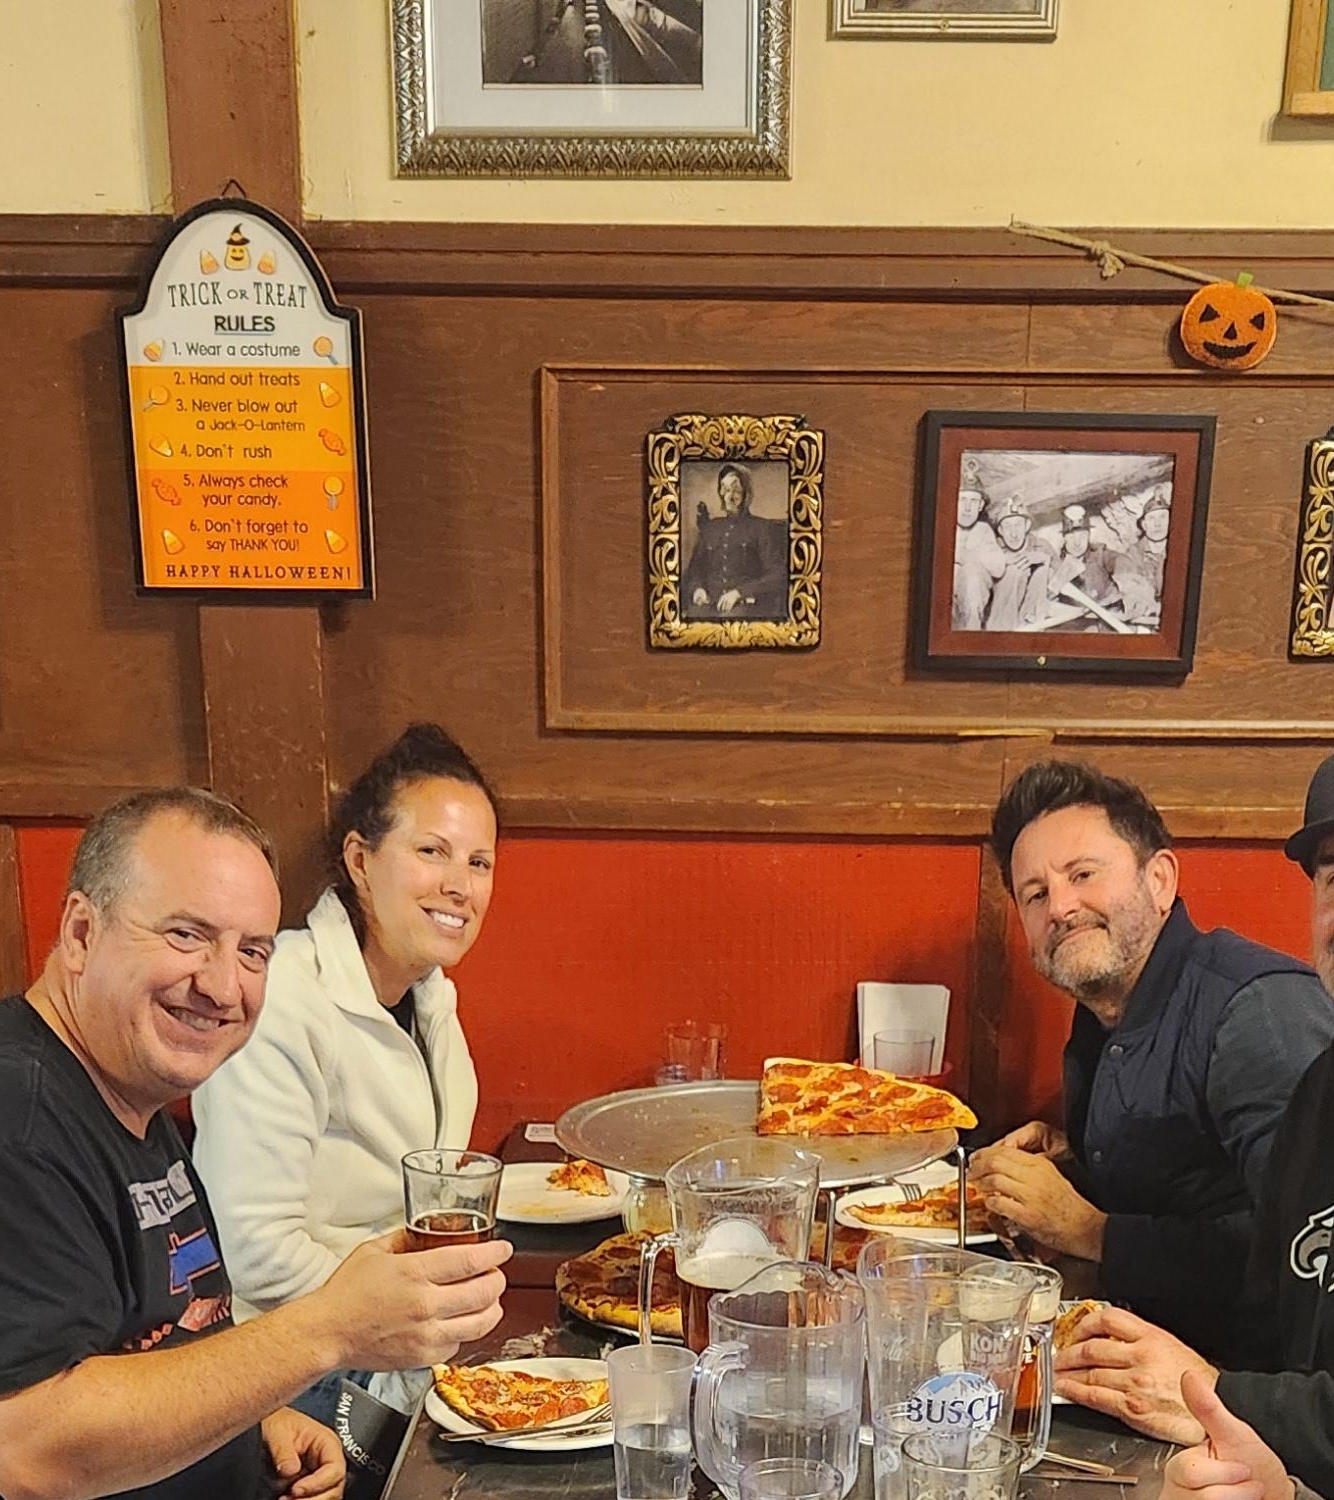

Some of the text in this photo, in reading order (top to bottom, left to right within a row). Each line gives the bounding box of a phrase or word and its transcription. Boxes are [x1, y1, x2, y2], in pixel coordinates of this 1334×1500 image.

[168, 281, 222, 308] TRICK
[253, 282, 307, 308] TREAT
[214, 315, 275, 333] RULES
[172, 341, 301, 357] 1. Wear a costume
[174, 371, 300, 386] 2. Hand out treats
[176, 398, 298, 413] 3. Never blow out
[196, 419, 305, 432] a Jack-O-Lantern
[181, 443, 272, 459] 4. Don't rush
[183, 474, 288, 489] 5. Always check
[202, 494, 282, 508] your candy.
[190, 518, 308, 536] 6. Don't forget to
[206, 539, 299, 552] say THANK YOU!
[167, 564, 351, 580] HAPPY HALLOWEEN!
[906, 1390, 1004, 1425] BUSCH
